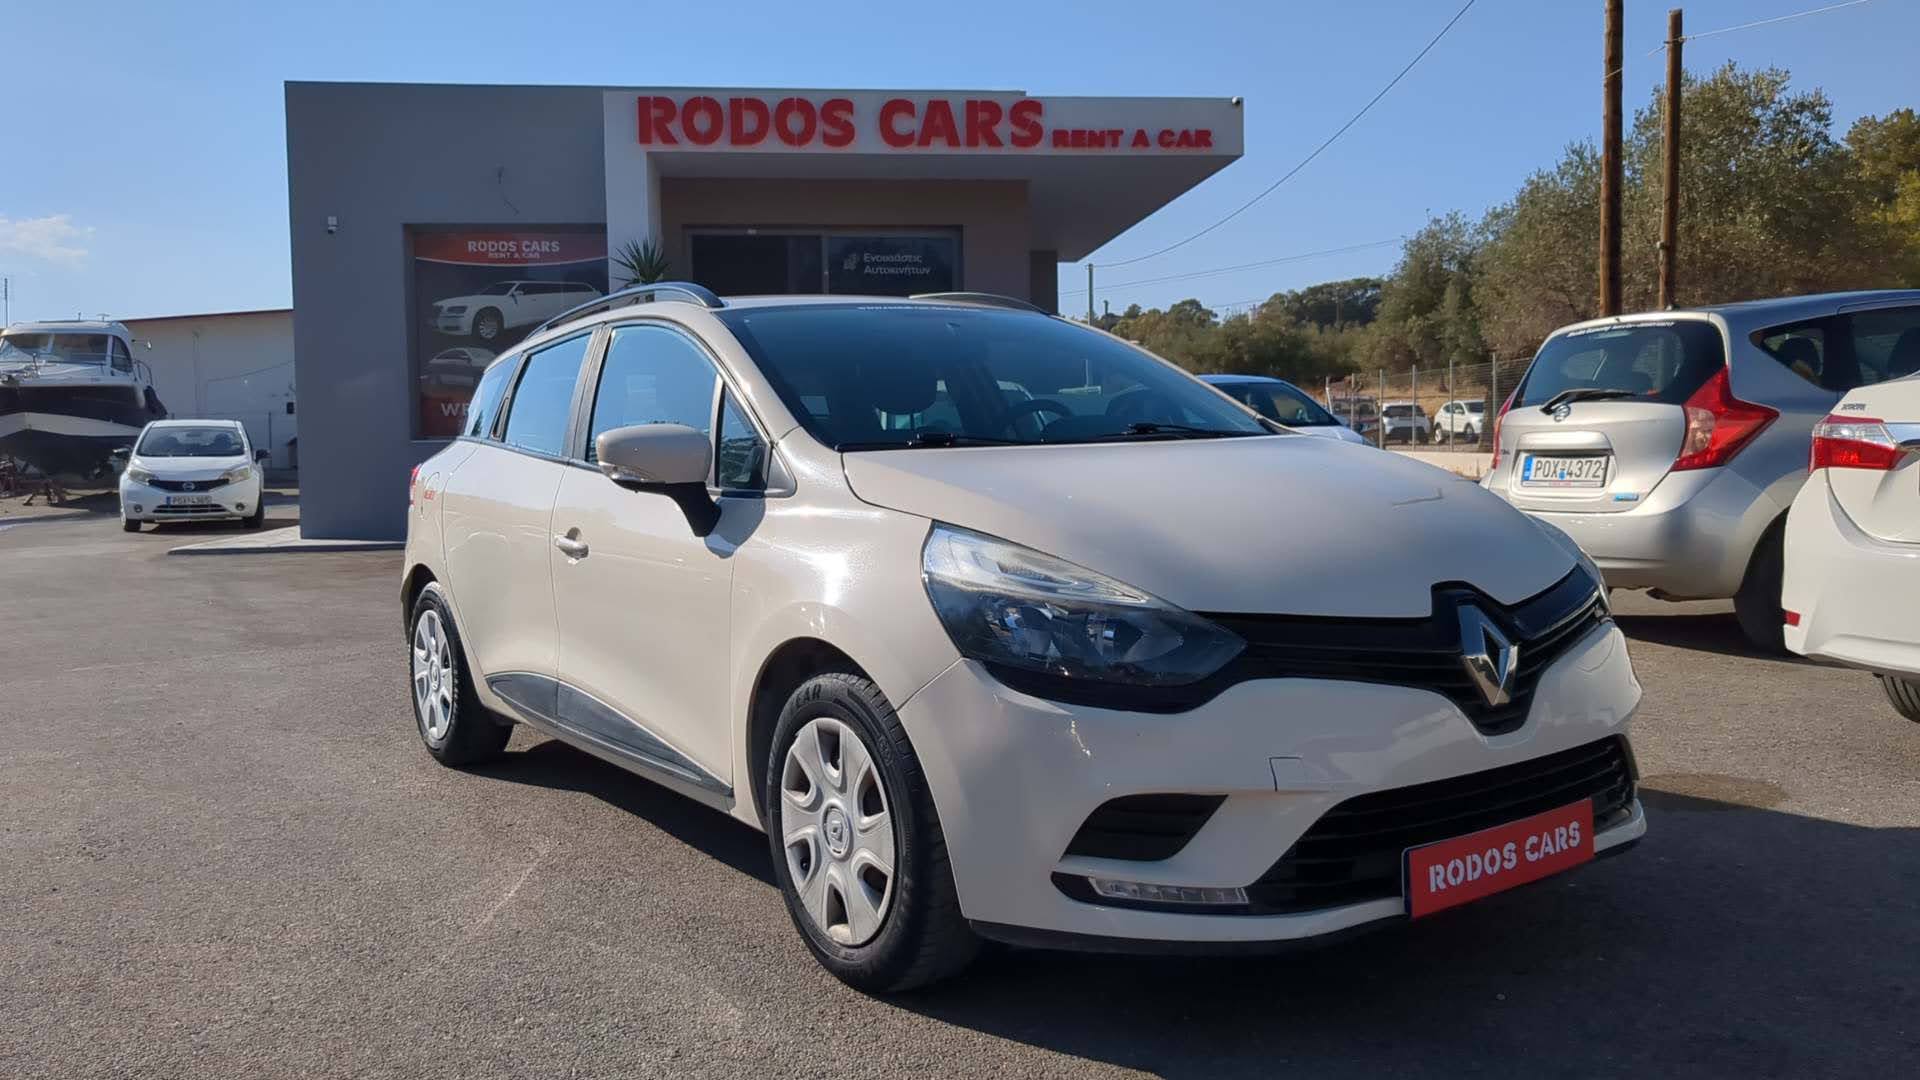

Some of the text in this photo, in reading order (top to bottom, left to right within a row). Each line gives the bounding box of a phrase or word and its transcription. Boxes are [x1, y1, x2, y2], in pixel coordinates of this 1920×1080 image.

[637, 96, 1213, 148] RODOS CARS RENT A CAR
[467, 240, 561, 253] RODOS CARS
[1428, 821, 1582, 893] RODOS CARS
